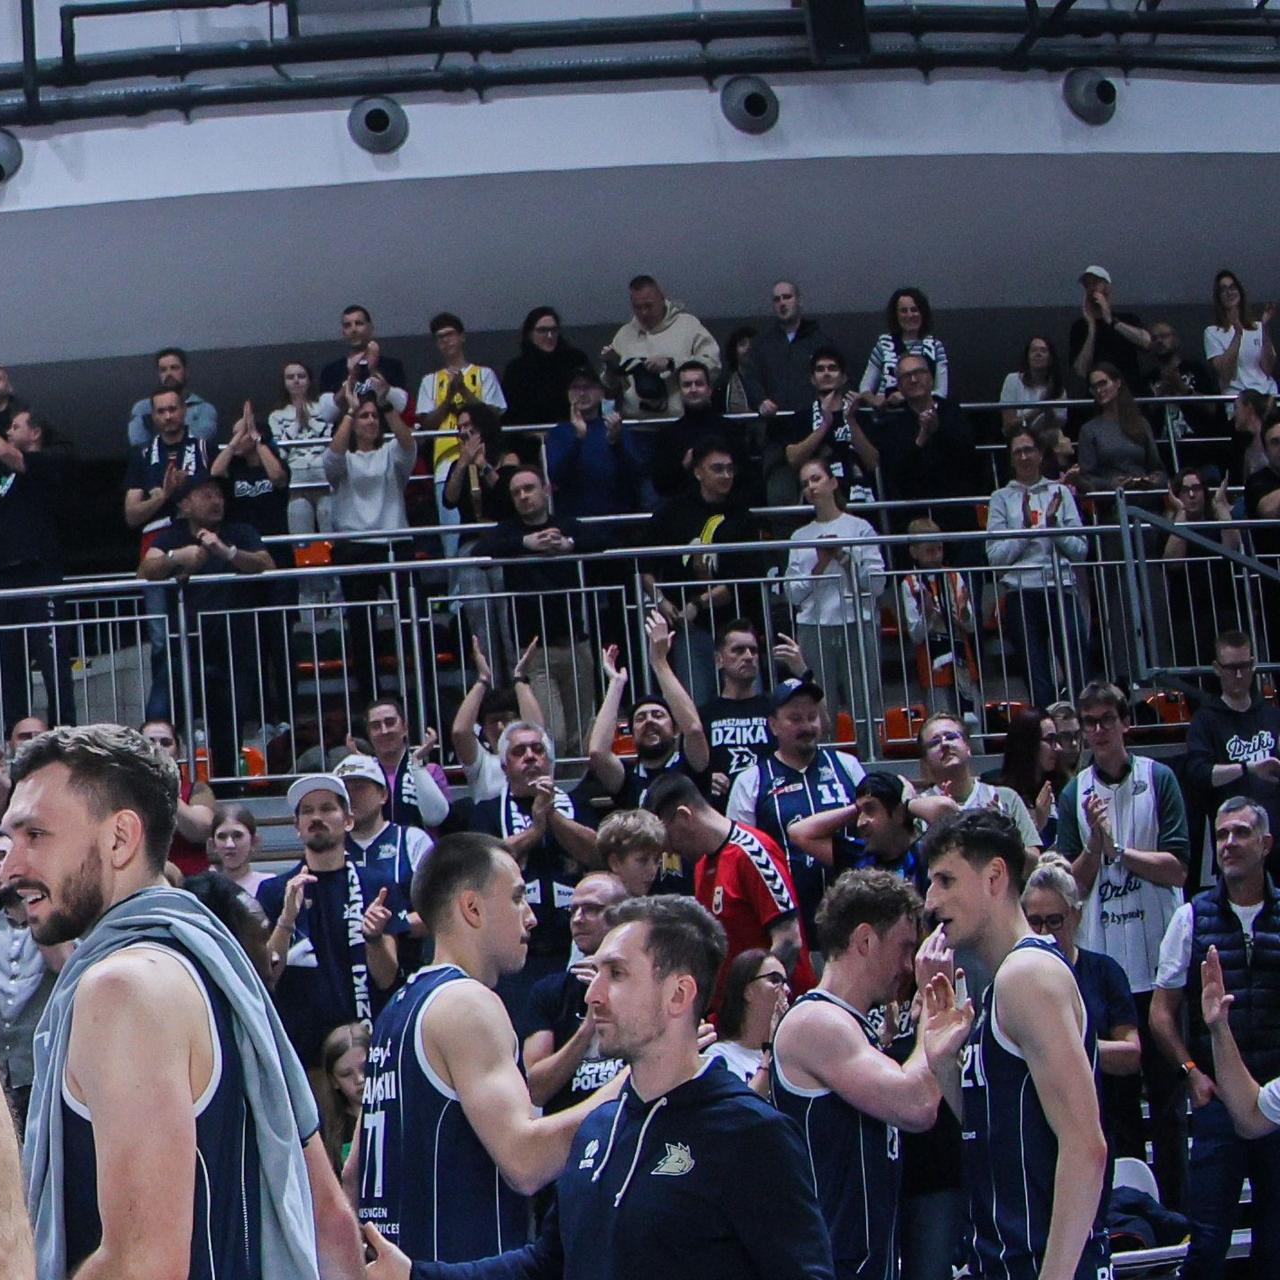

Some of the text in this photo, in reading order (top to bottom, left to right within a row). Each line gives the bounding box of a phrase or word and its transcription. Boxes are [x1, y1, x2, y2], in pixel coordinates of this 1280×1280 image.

[751, 717, 767, 727] JEST
[711, 725, 768, 747] DZIKA
[817, 783, 851, 805] 11
